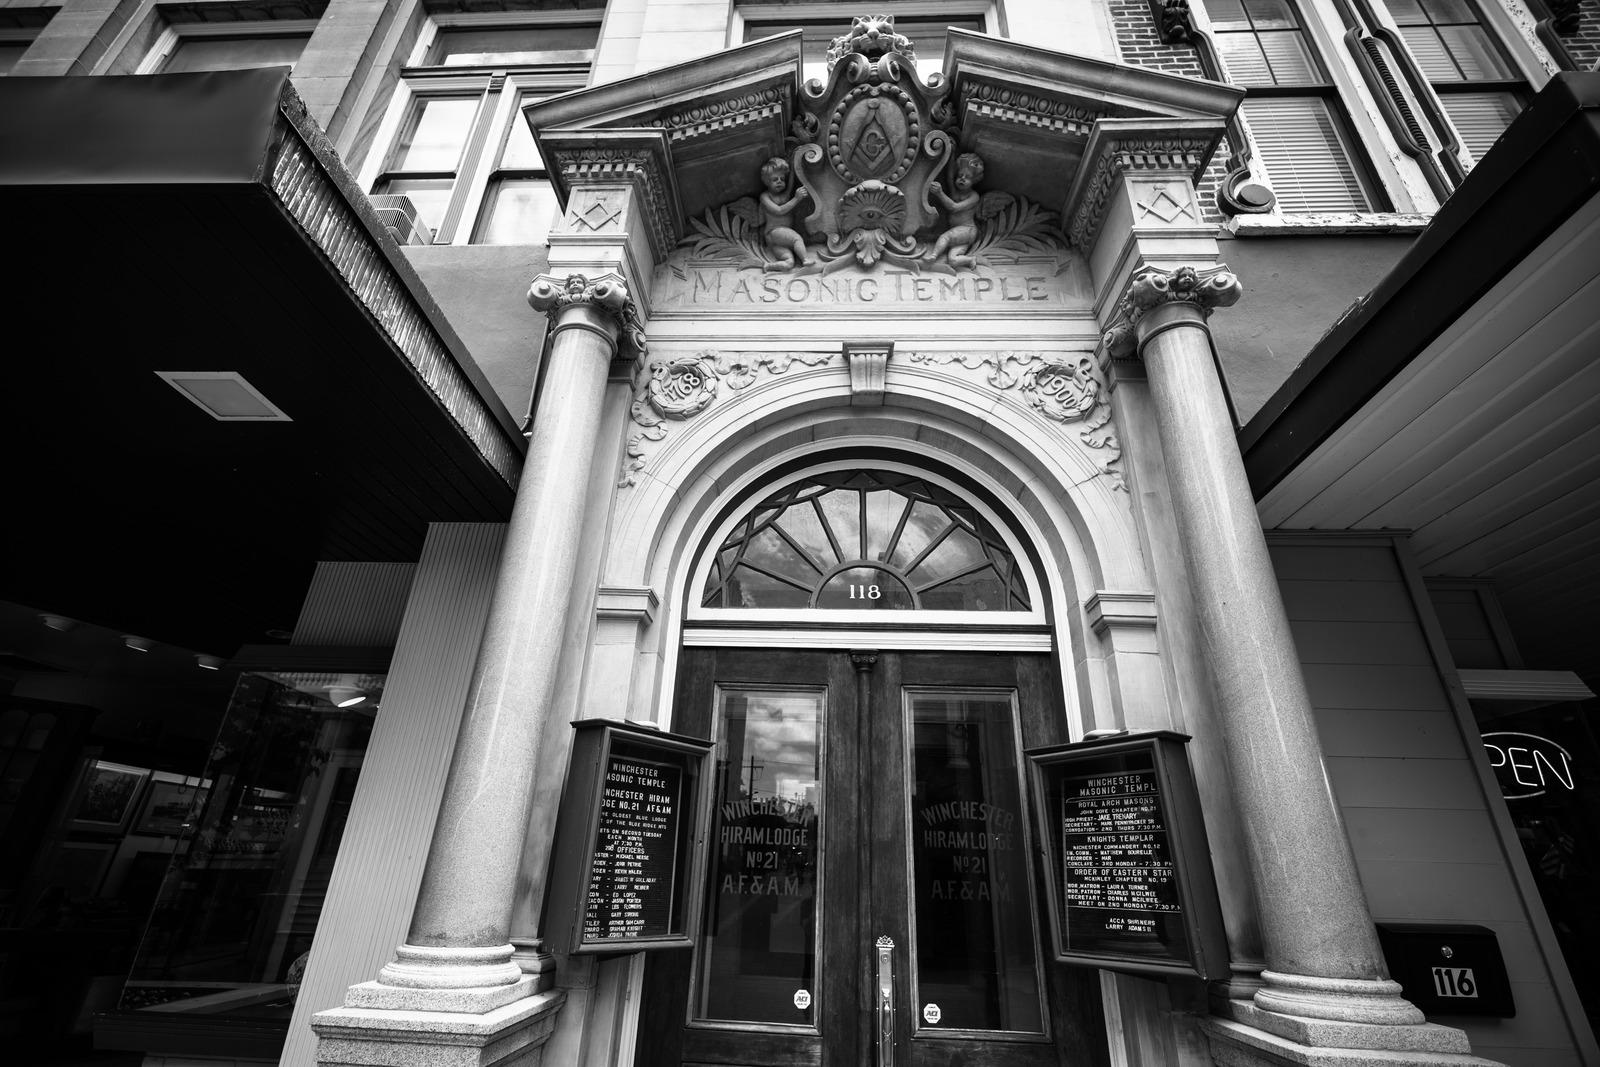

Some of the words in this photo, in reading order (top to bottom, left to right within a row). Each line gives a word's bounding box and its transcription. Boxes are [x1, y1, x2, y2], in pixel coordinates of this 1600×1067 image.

[693, 270, 878, 304] MASONIC
[884, 270, 1049, 301] TEMPLE
[1040, 374, 1077, 409] 1900
[850, 584, 881, 599] 118
[613, 763, 658, 777] WINCHESTER
[1484, 744, 1574, 789] PEN
[607, 773, 633, 783] ASONIC
[638, 777, 665, 788] TEMPLE
[1080, 786, 1116, 796] MASONIC
[1125, 784, 1155, 792] TEMPL
[1088, 776, 1140, 787] WINCHESTER
[606, 789, 643, 800] NCHESTER
[649, 794, 670, 804] HIRAM
[721, 797, 811, 827] WINCHESTER
[920, 801, 1014, 831] WINCHESTER
[721, 826, 763, 845] HIRAM
[766, 828, 808, 846] LODGE
[924, 830, 968, 848] HIRAM
[971, 832, 1013, 850] LODGE
[617, 846, 645, 854] OFFICERS
[1434, 969, 1475, 996] 116
